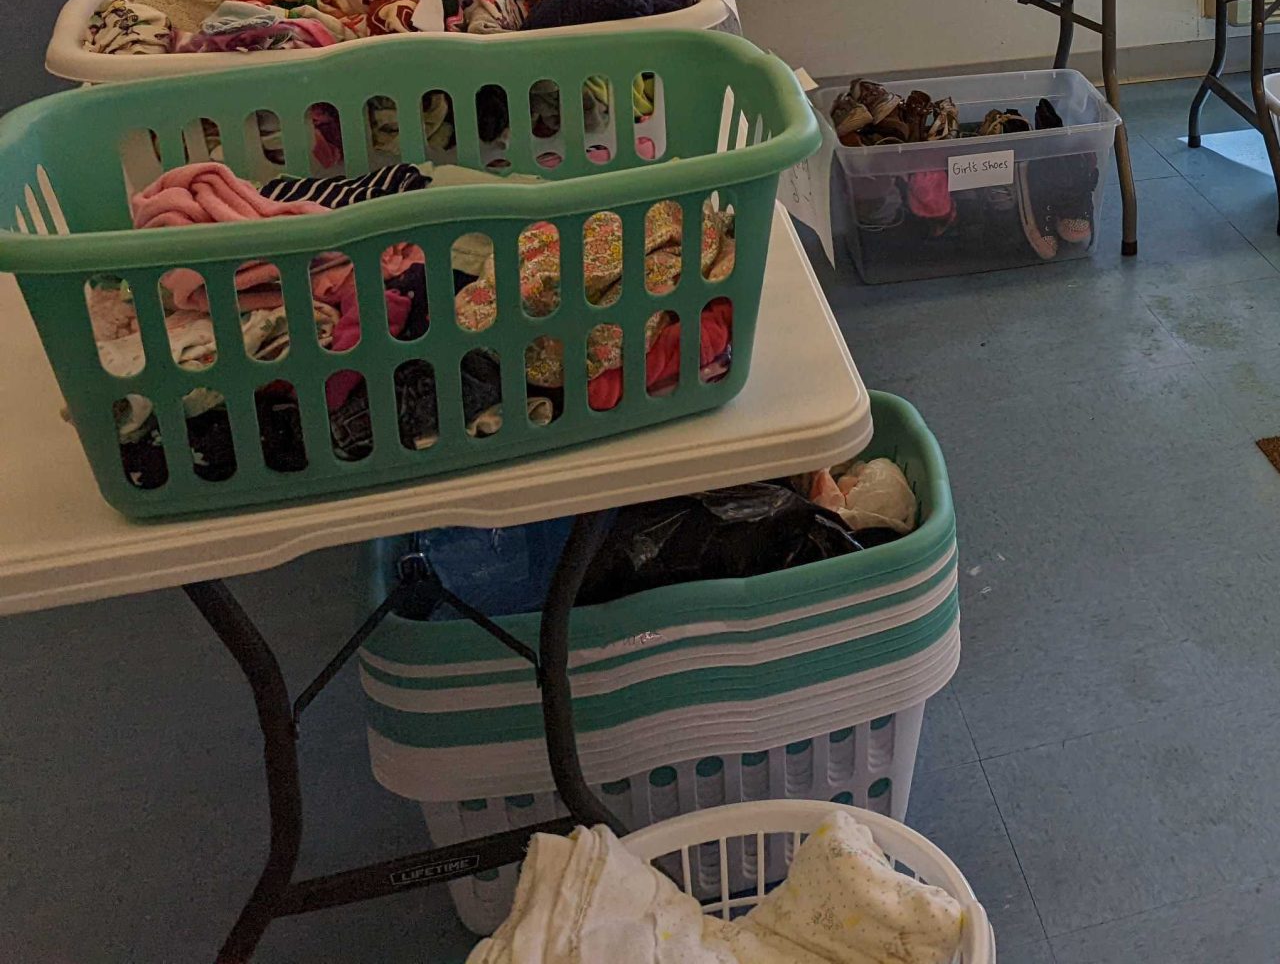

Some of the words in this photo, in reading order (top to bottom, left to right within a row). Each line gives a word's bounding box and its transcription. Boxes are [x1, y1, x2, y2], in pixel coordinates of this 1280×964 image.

[952, 160, 978, 176] Girl's
[981, 159, 1009, 172] Shoes
[401, 859, 470, 881] LIFETIME
